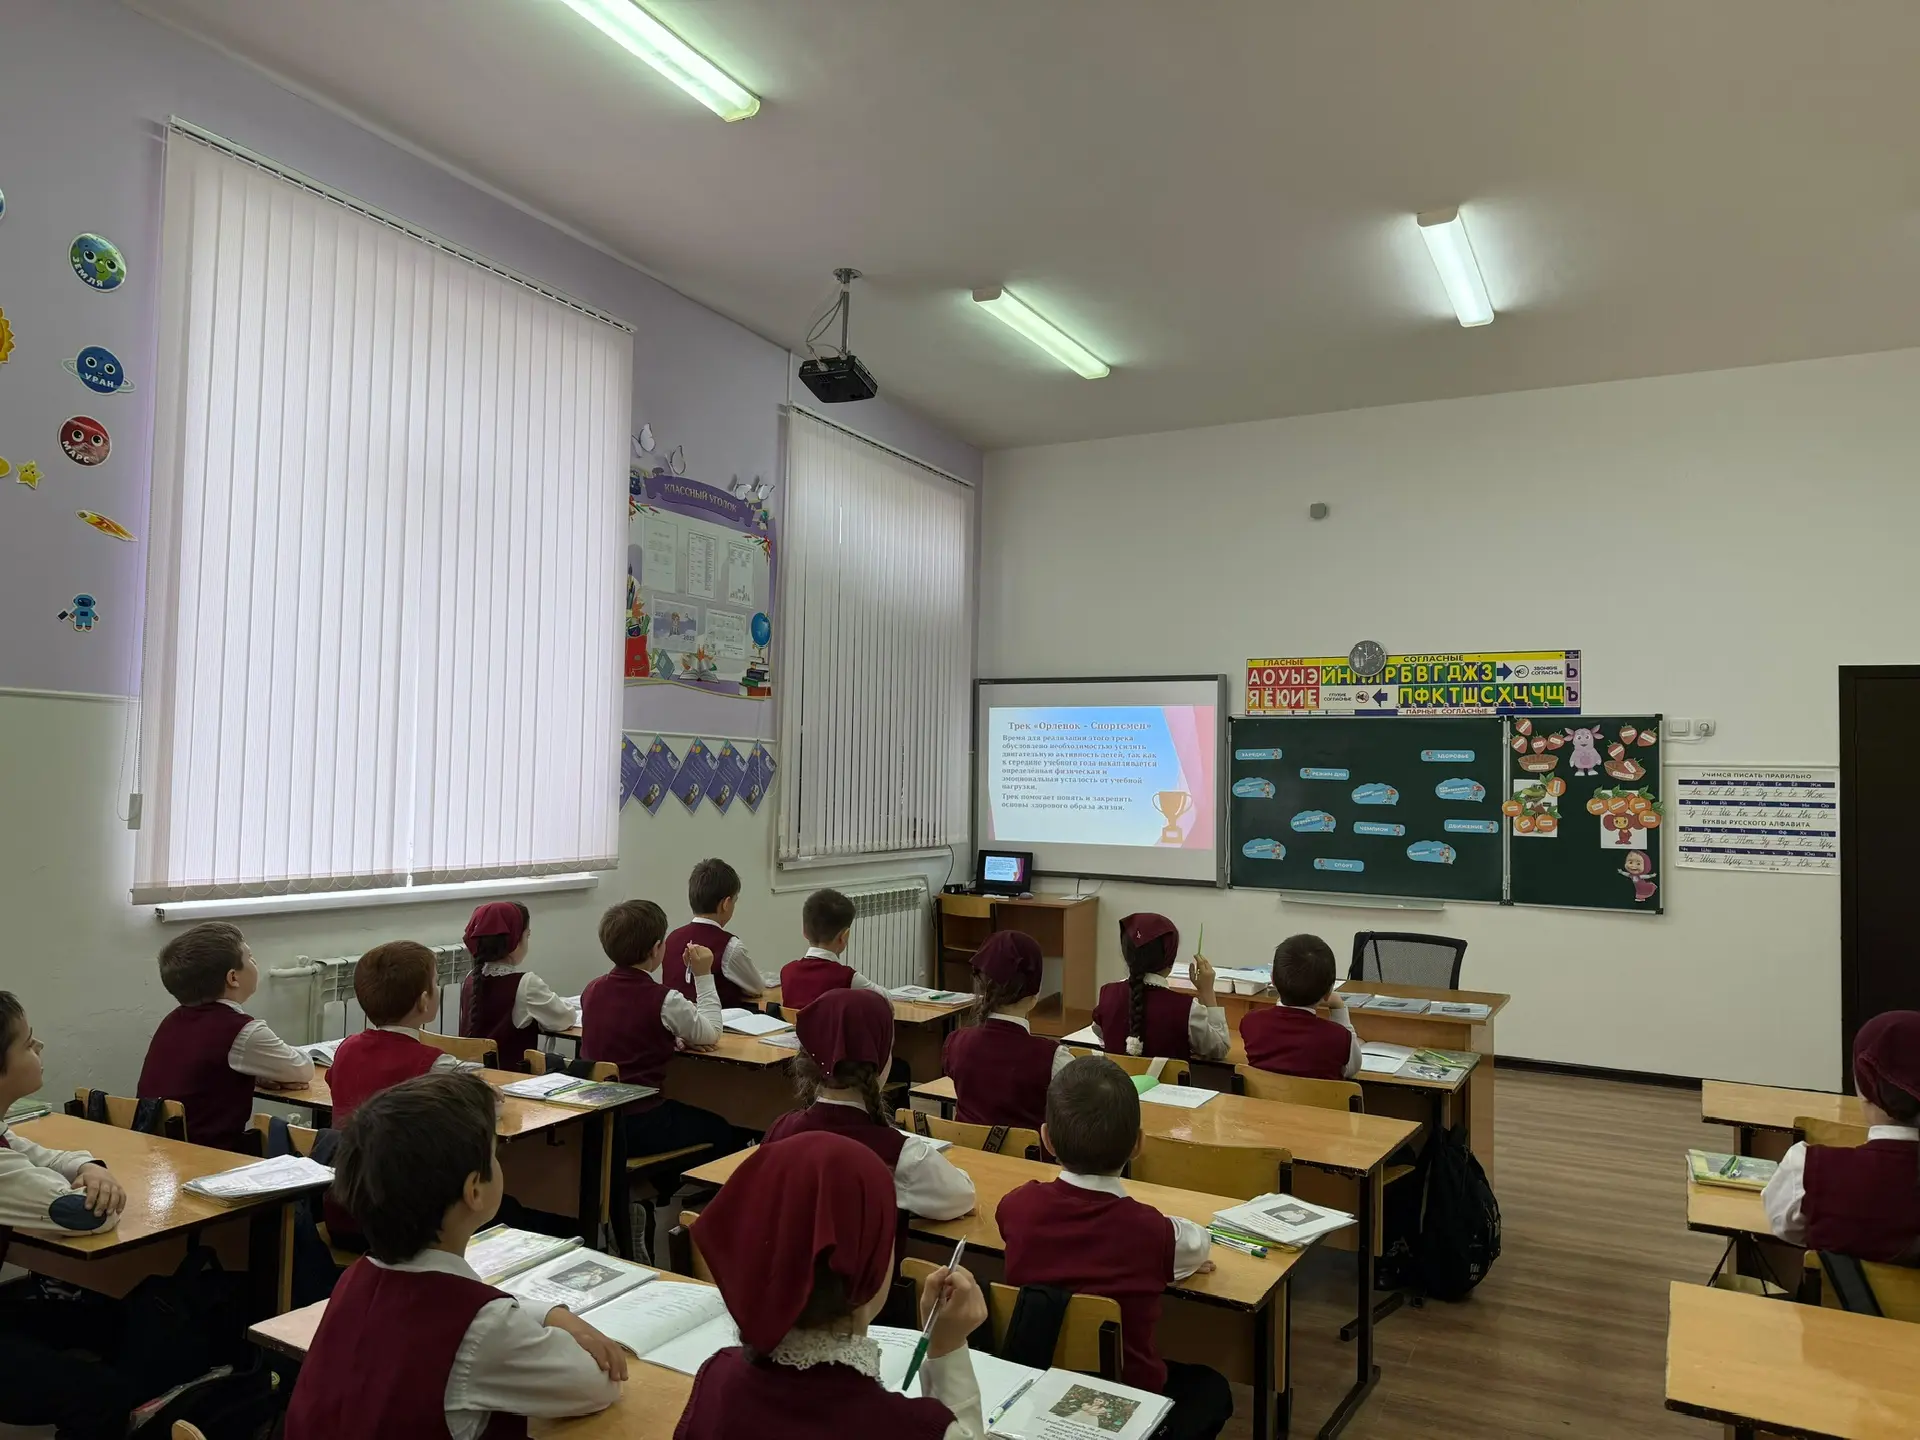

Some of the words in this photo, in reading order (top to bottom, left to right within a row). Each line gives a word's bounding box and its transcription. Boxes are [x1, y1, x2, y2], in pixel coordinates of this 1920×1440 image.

[73, 256, 104, 287] ЗЕМЛЯ
[84, 373, 114, 388] УРАН
[62, 440, 90, 464] МАРС
[664, 484, 708, 501] КЛАССНЫЙ
[709, 495, 737, 512] УГОЛОК
[1008, 722, 1031, 730] Трек
[1091, 722, 1151, 731] Спортсмен»
